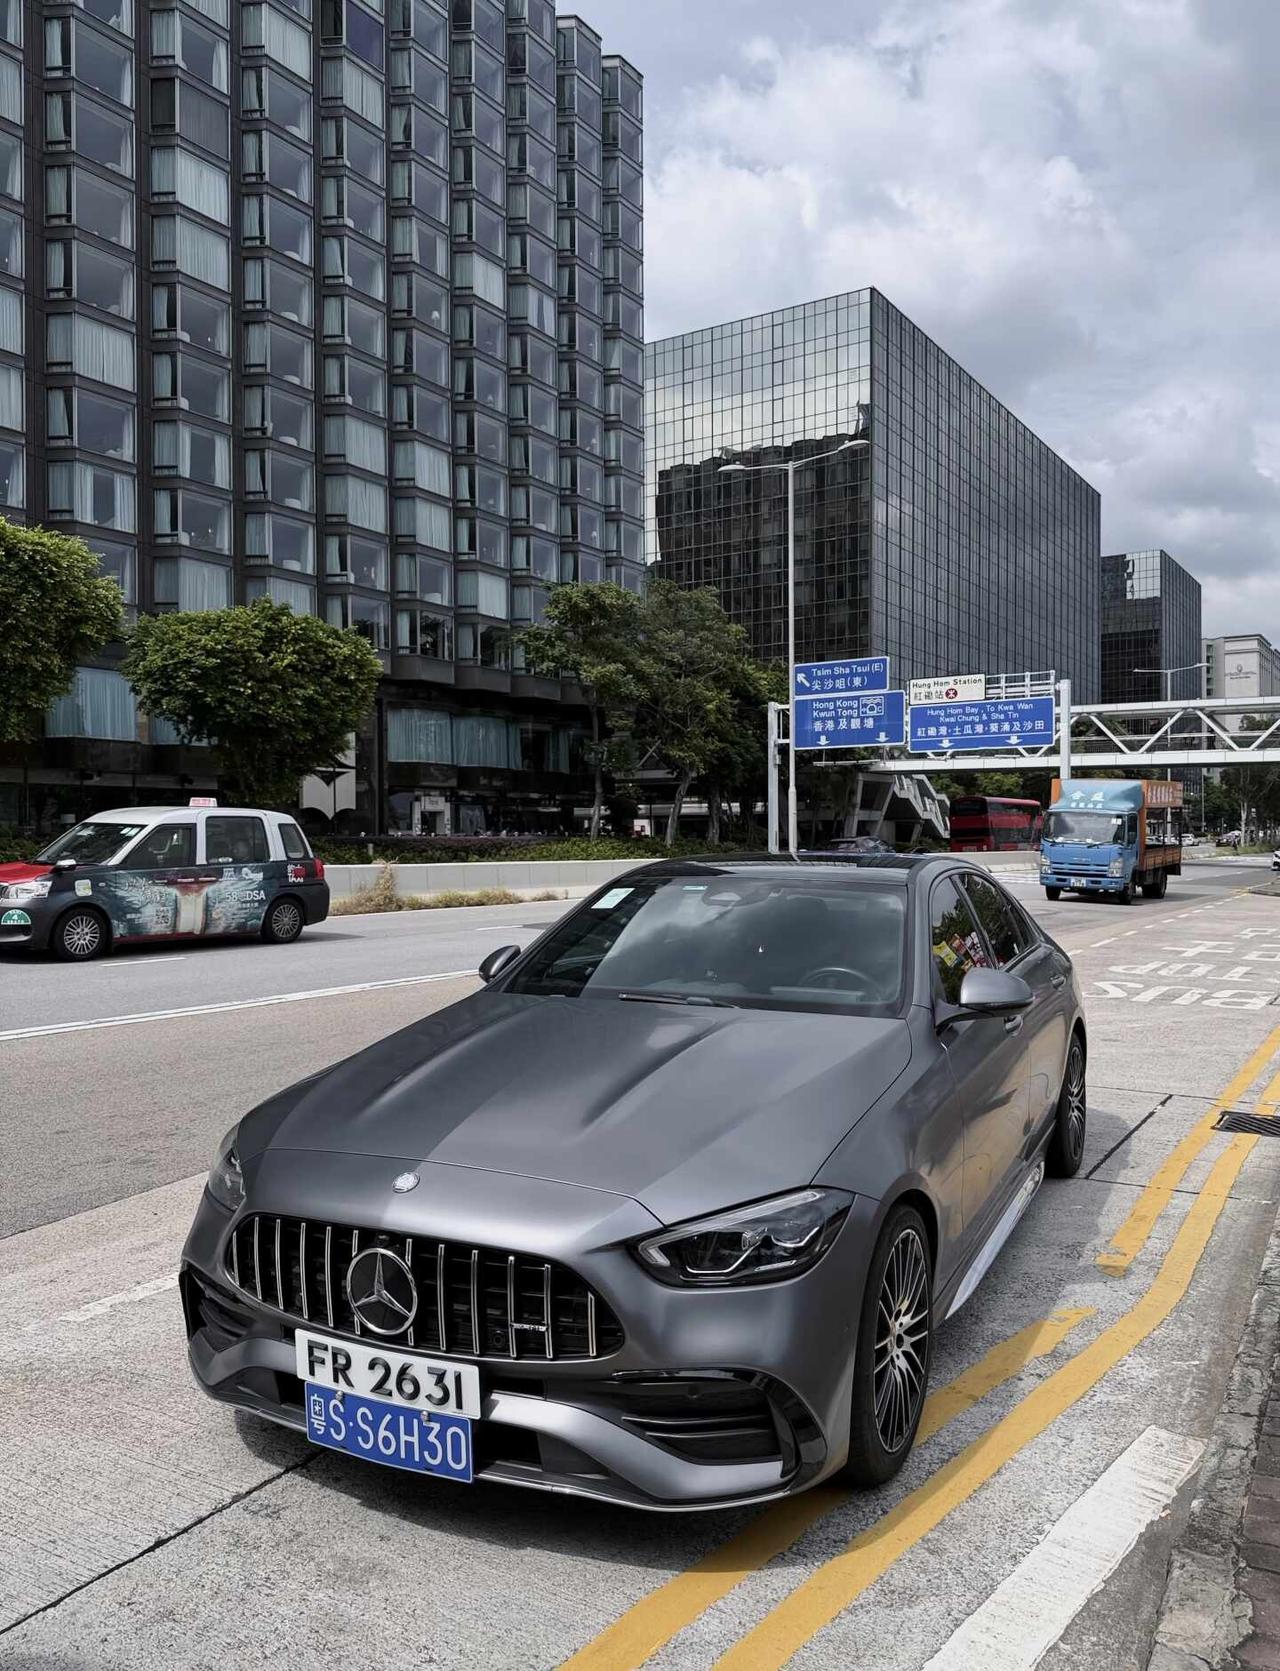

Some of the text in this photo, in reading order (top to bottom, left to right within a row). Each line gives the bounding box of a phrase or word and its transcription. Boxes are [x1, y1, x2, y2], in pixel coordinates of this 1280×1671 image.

[812, 662, 884, 677] Tsim Sha Tsui (E)
[912, 677, 982, 690] Hung Hom Station
[914, 689, 944, 701] 紅磡站
[813, 699, 858, 710] Hong Kong
[927, 708, 945, 716] Hung
[947, 706, 963, 715] Hom
[986, 704, 995, 712] To
[997, 703, 1014, 711] Kwa
[1017, 702, 1033, 710] Wan
[813, 708, 858, 718] Kwun Tong
[939, 715, 956, 723] Kwai
[957, 714, 979, 723] Chung
[991, 712, 1005, 720] Sha
[1007, 711, 1019, 719] Tin
[813, 717, 875, 732] 香港及觀塘
[1082, 981, 1276, 1010] BUS
[307, 1339, 463, 1410] FR 2631
